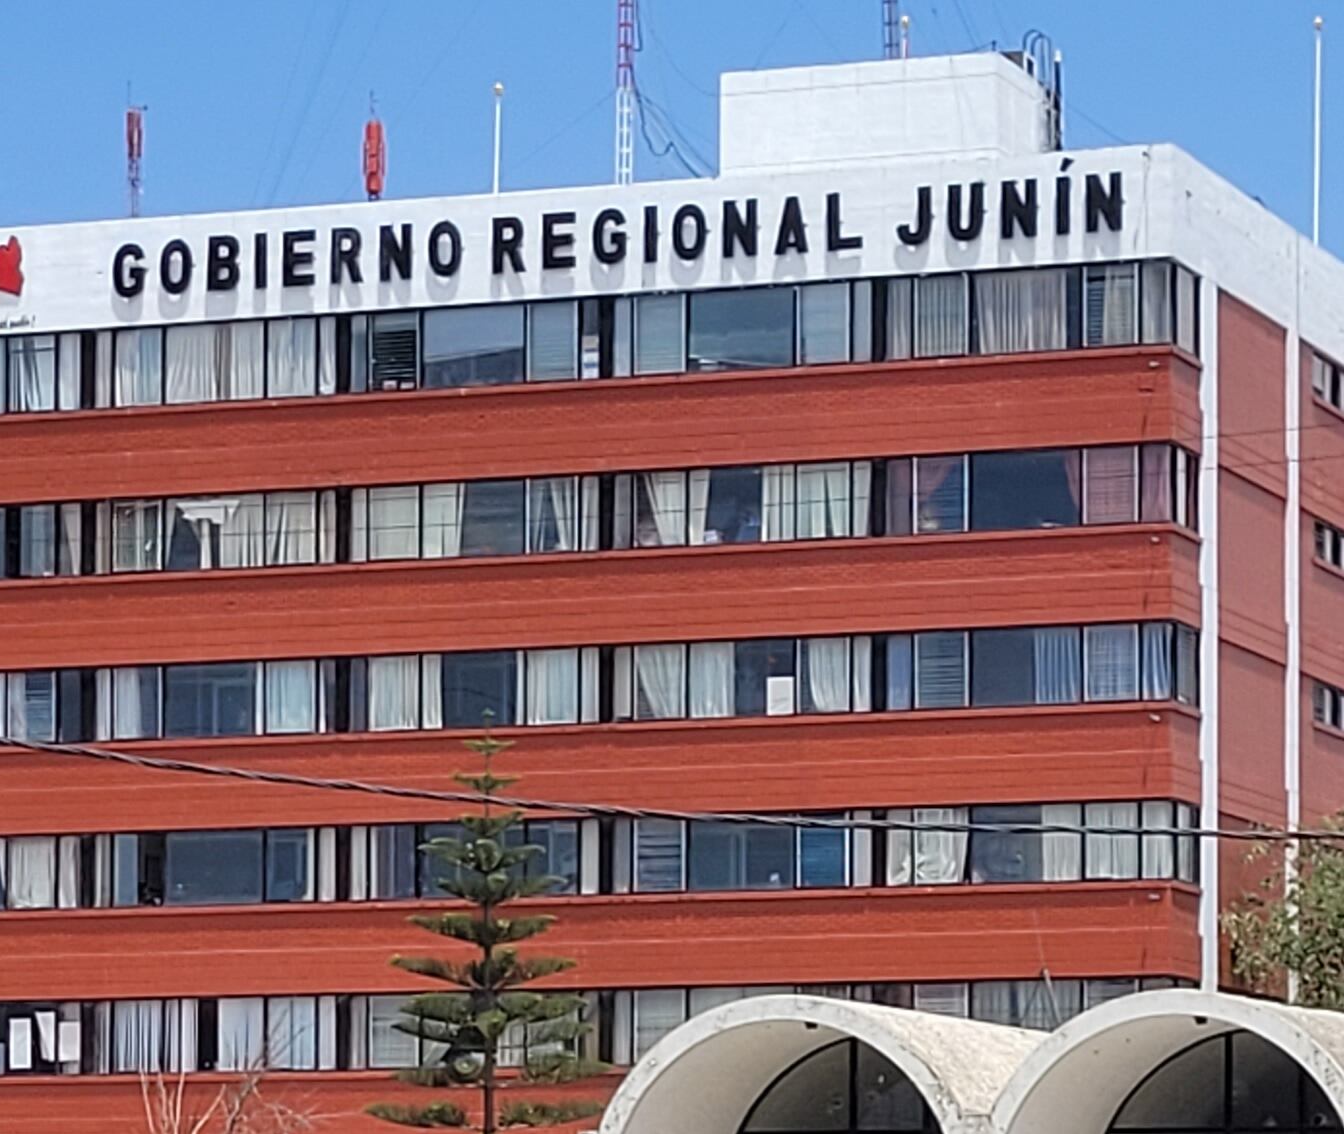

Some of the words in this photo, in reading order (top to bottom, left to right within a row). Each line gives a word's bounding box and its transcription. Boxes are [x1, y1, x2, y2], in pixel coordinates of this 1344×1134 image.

[112, 219, 462, 299] GOBIERNO
[492, 192, 864, 275] REGIONAL
[896, 158, 1123, 247] JUNÍN
